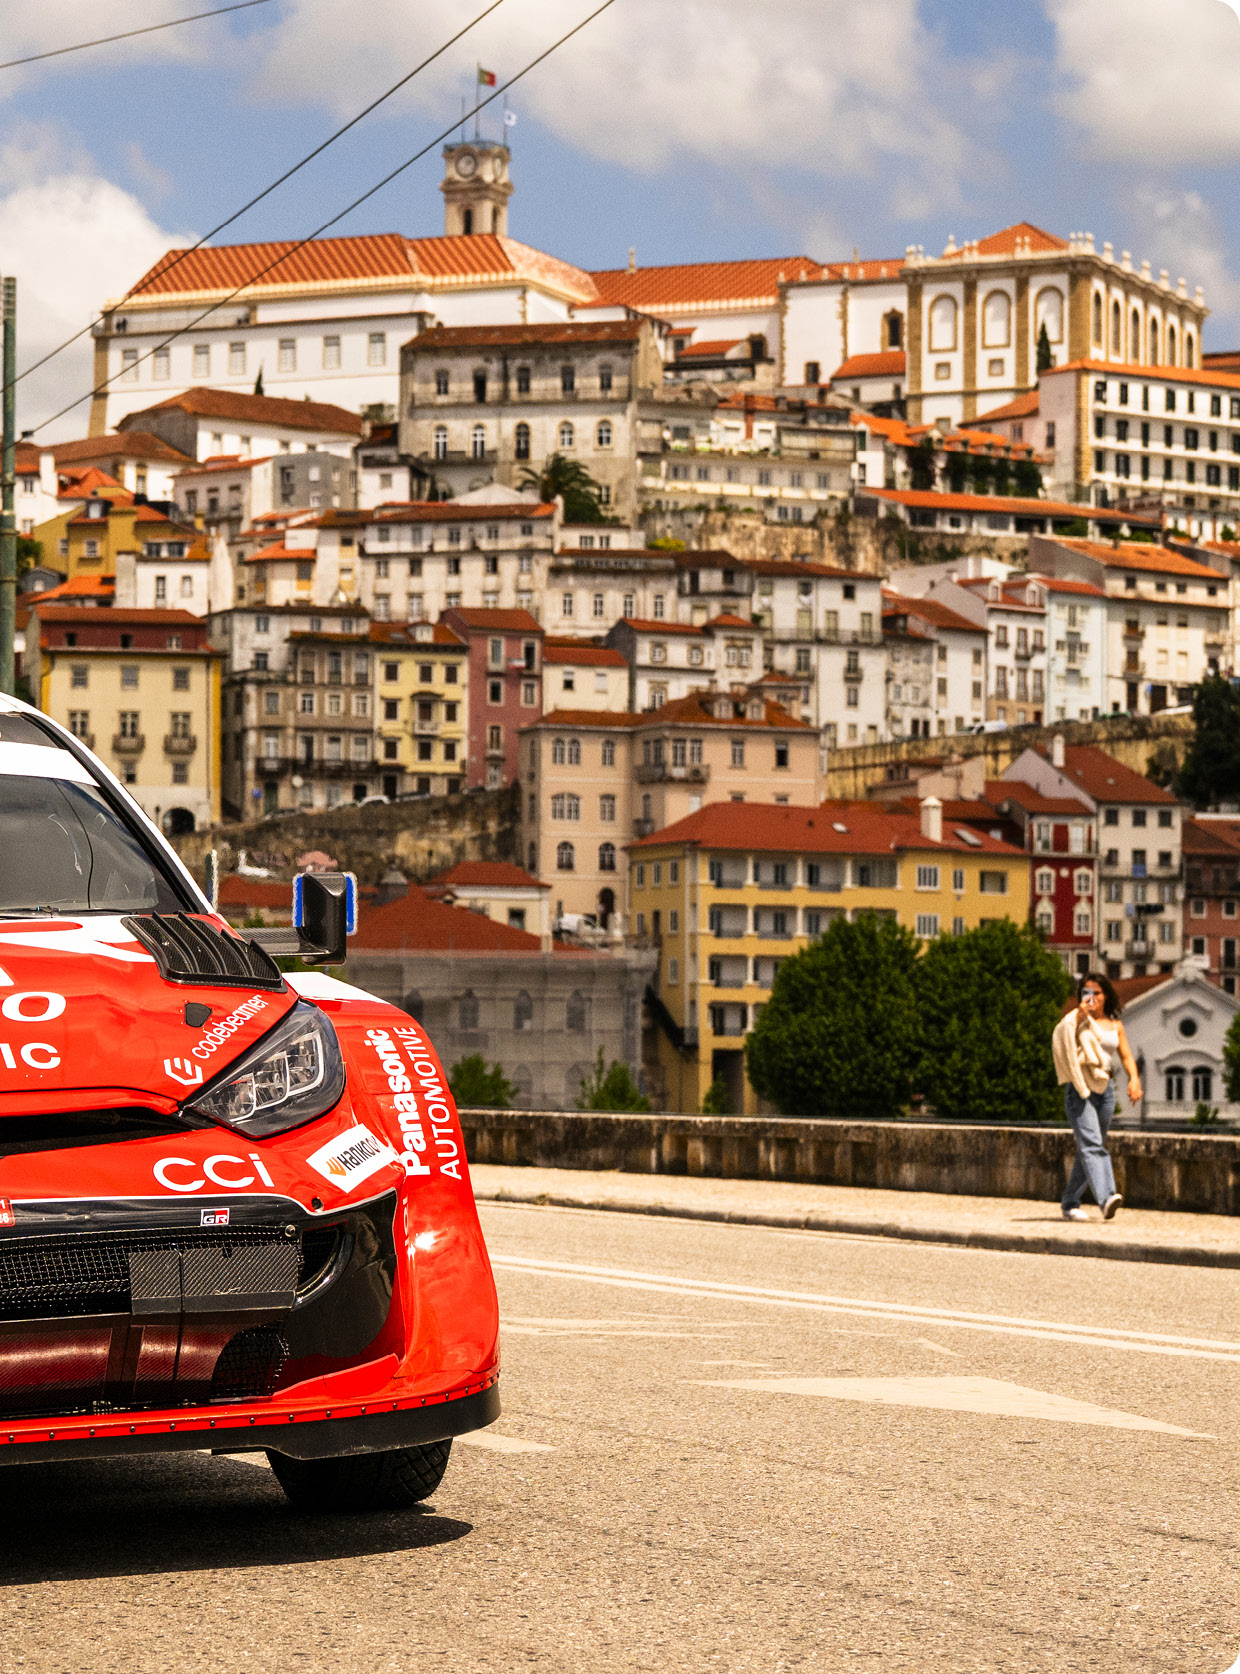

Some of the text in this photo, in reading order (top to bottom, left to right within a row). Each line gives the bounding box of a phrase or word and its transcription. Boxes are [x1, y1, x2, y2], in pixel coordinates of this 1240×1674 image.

[191, 994, 269, 1059] codebeamer
[364, 1028, 431, 1176] Panasonic
[393, 1026, 462, 1180] AUTOMOTIVE
[153, 1153, 275, 1192] CCi
[202, 1212, 228, 1225] GR
